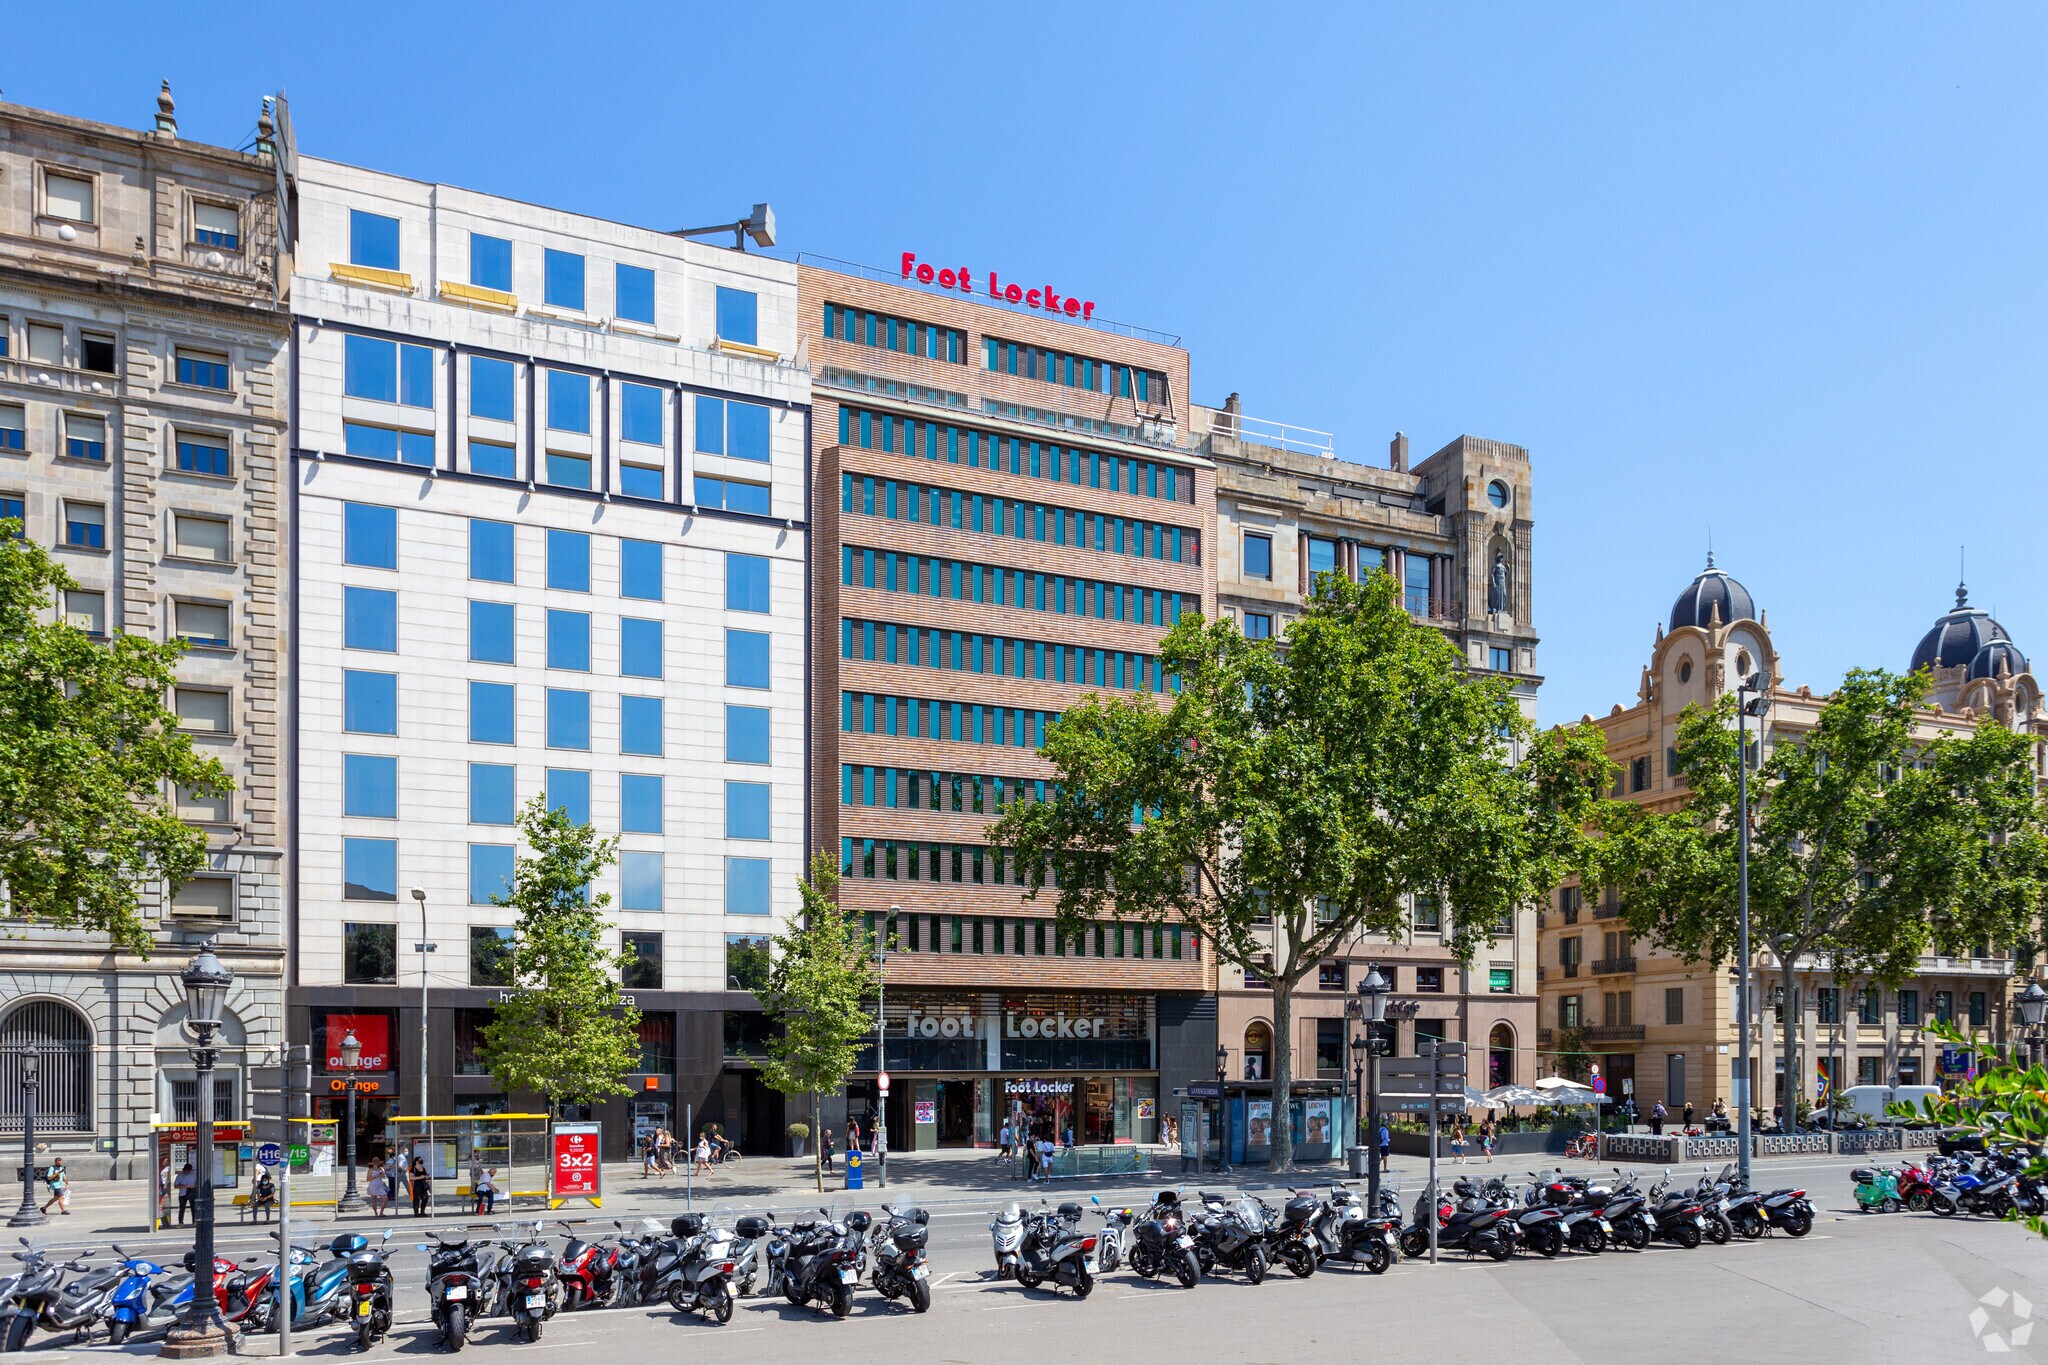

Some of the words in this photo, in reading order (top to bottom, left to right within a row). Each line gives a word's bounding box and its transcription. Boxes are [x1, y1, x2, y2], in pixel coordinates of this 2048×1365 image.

[902, 252, 971, 293] Foot
[989, 272, 1095, 320] Locker
[907, 1010, 975, 1038] Foot
[1006, 1011, 1104, 1038] Locker
[329, 1056, 381, 1068] ornge
[330, 1079, 379, 1092] Ornge
[1004, 1080, 1031, 1093] Foot
[1034, 1081, 1075, 1093] Locker
[259, 1149, 280, 1160] H16
[560, 1153, 593, 1167] 3x2
